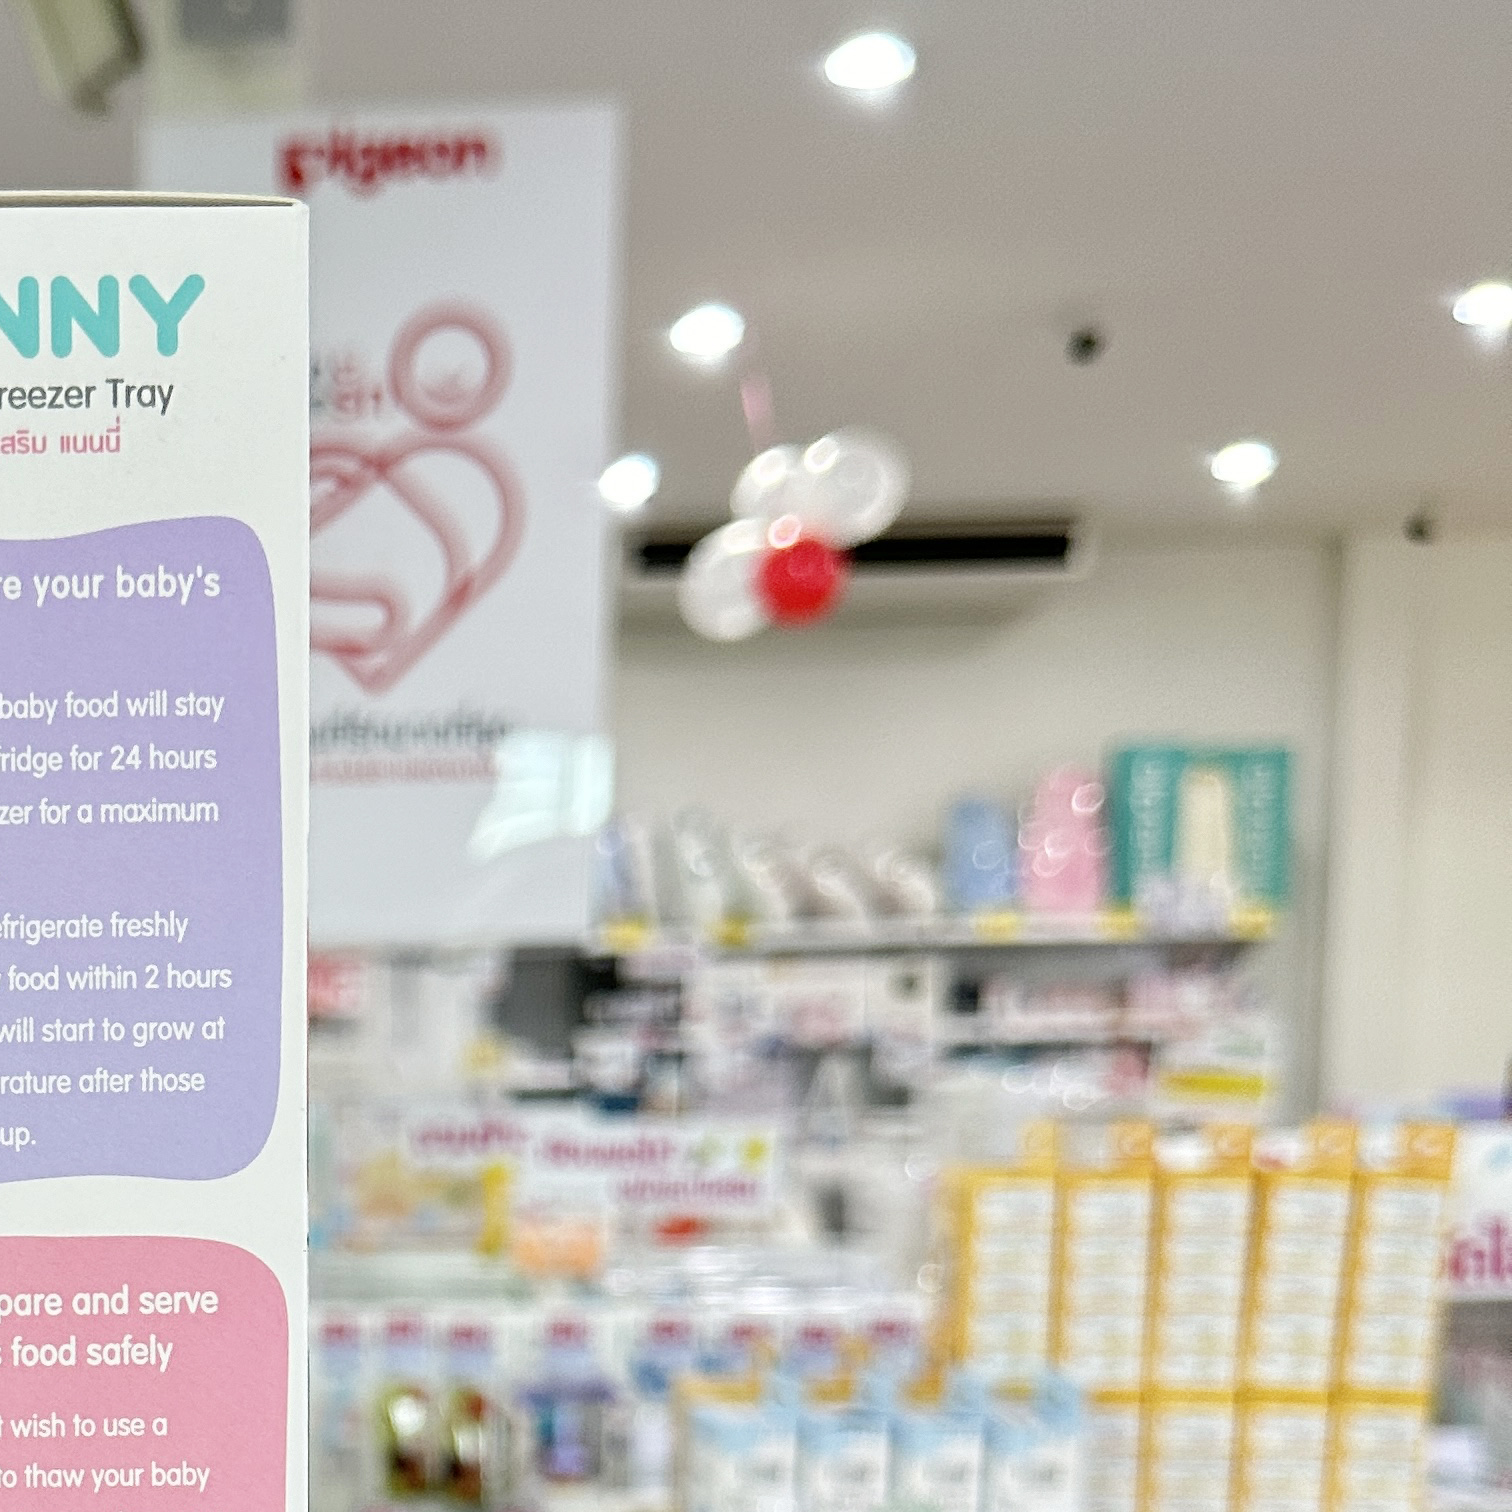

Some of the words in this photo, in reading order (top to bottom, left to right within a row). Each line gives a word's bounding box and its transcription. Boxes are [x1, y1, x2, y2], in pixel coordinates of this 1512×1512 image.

[105, 378, 173, 418] Tray
[33, 575, 104, 607] your
[117, 564, 220, 605] baby's
[64, 691, 118, 718] food
[126, 690, 167, 716] will
[175, 692, 224, 722] stay
[70, 744, 102, 770] for
[111, 745, 142, 770] 24
[150, 743, 217, 769] hours
[110, 910, 188, 943] freshly
[79, 1067, 133, 1093] after
[140, 1067, 205, 1092] those
[0, 1127, 36, 1152] up.
[72, 1284, 128, 1315] and
[139, 1291, 218, 1314] serve
[11, 1335, 76, 1366] food
[87, 1334, 173, 1372] safely
[24, 1463, 84, 1488] thaw
[91, 1468, 144, 1493] your
[152, 1461, 210, 1492] baby
